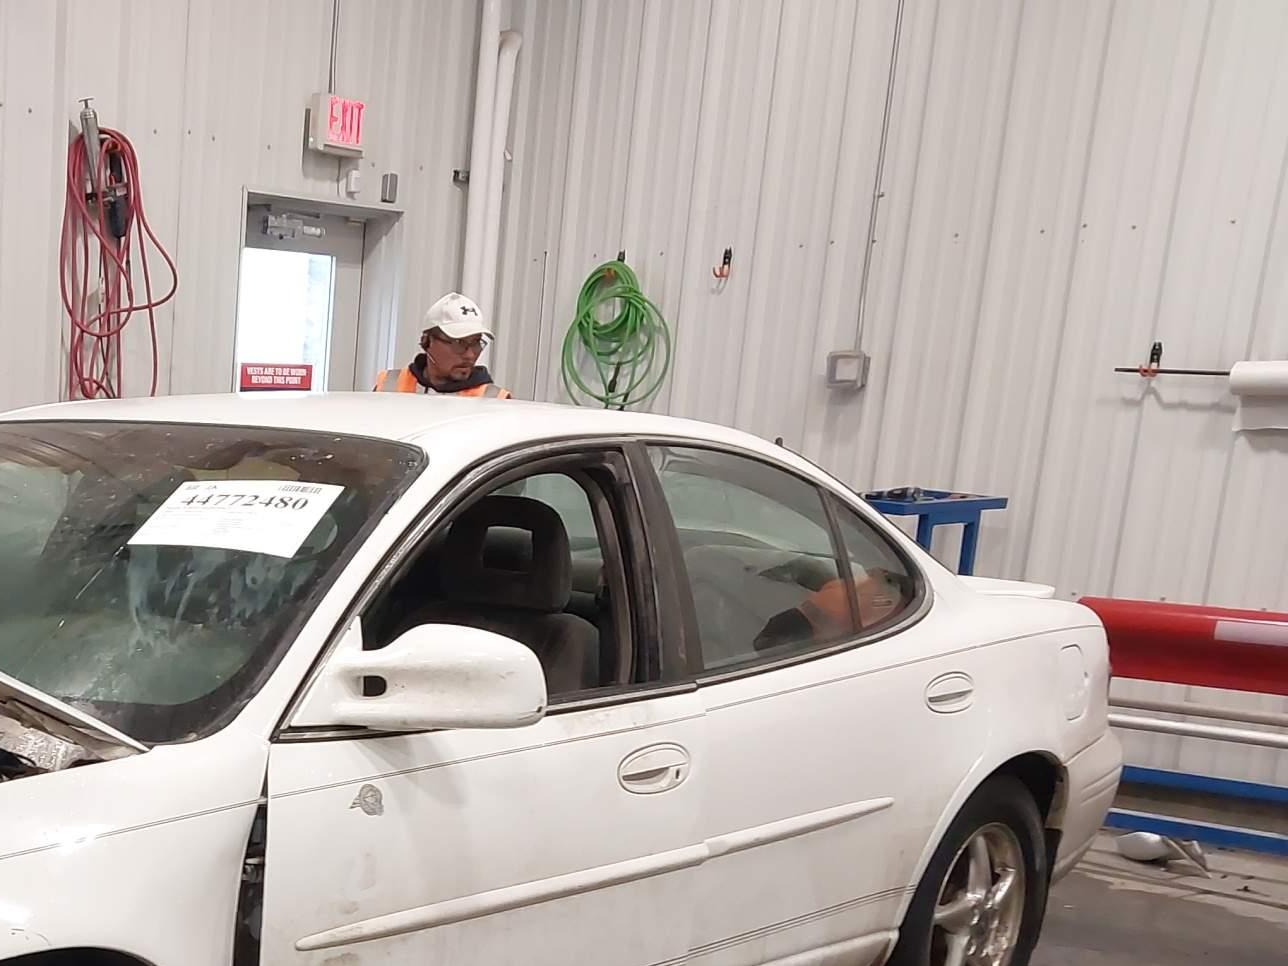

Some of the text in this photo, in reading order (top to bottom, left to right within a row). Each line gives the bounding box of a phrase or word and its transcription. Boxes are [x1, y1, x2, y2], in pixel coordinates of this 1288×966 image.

[328, 96, 364, 145] EXIT
[264, 367, 275, 376] ARE
[275, 368, 282, 376] TO
[181, 494, 309, 511] 44772480
